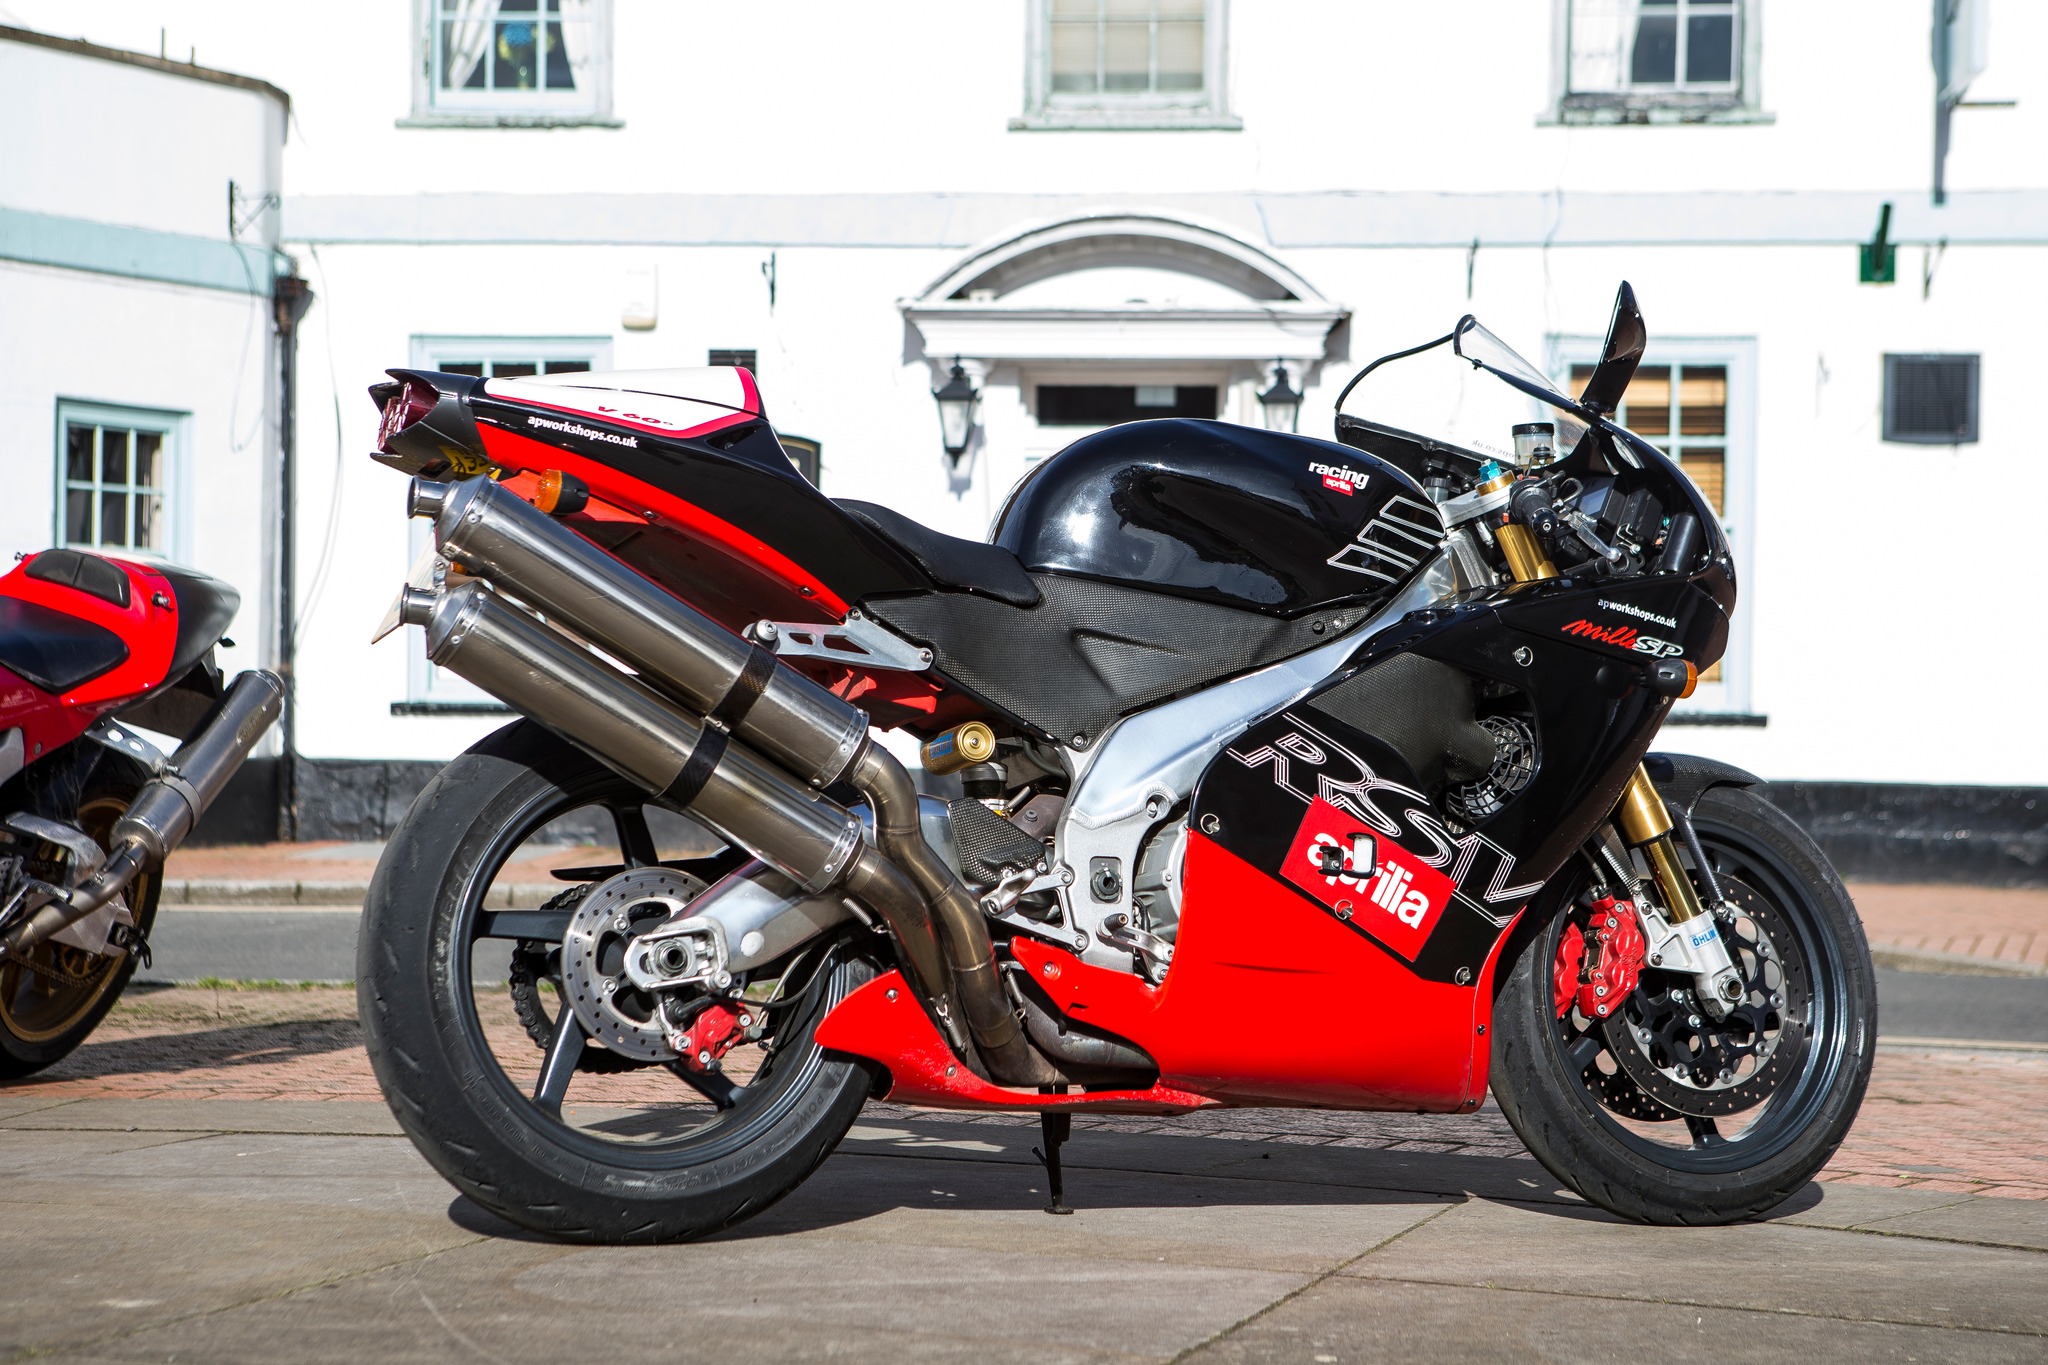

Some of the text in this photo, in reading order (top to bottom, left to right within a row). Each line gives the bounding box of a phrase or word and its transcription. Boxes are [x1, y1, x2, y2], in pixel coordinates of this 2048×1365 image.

[527, 415, 639, 449] apworkshops.co.uk
[1308, 461, 1370, 490] racing
[1325, 478, 1351, 492] aprilia
[1597, 598, 1678, 629] apworkshops.co.uk
